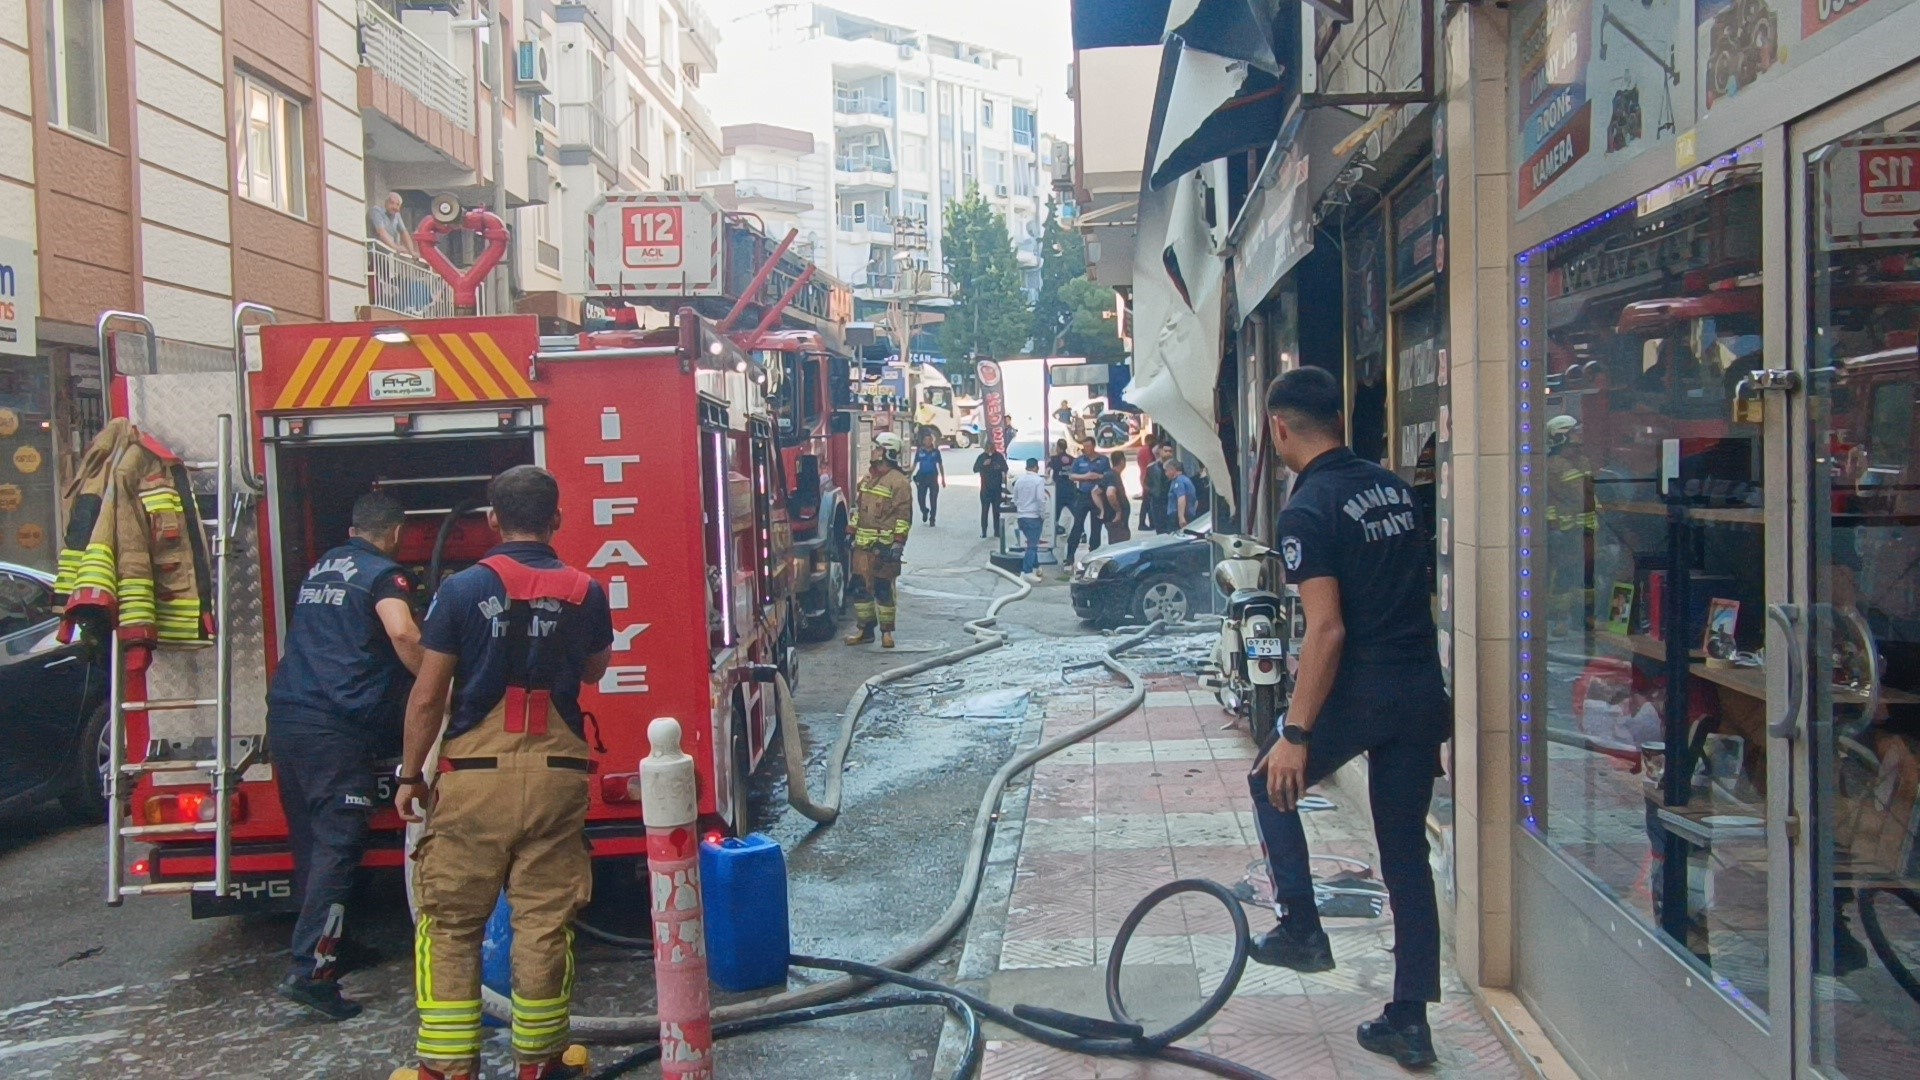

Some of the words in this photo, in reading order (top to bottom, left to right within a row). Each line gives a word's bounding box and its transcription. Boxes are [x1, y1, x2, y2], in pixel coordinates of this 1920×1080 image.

[1532, 134, 1574, 190] KAMERA
[631, 213, 674, 242] 112
[382, 377, 422, 387] AYG
[1342, 483, 1413, 522] MANİSA
[584, 406, 651, 693] İTFAİYE
